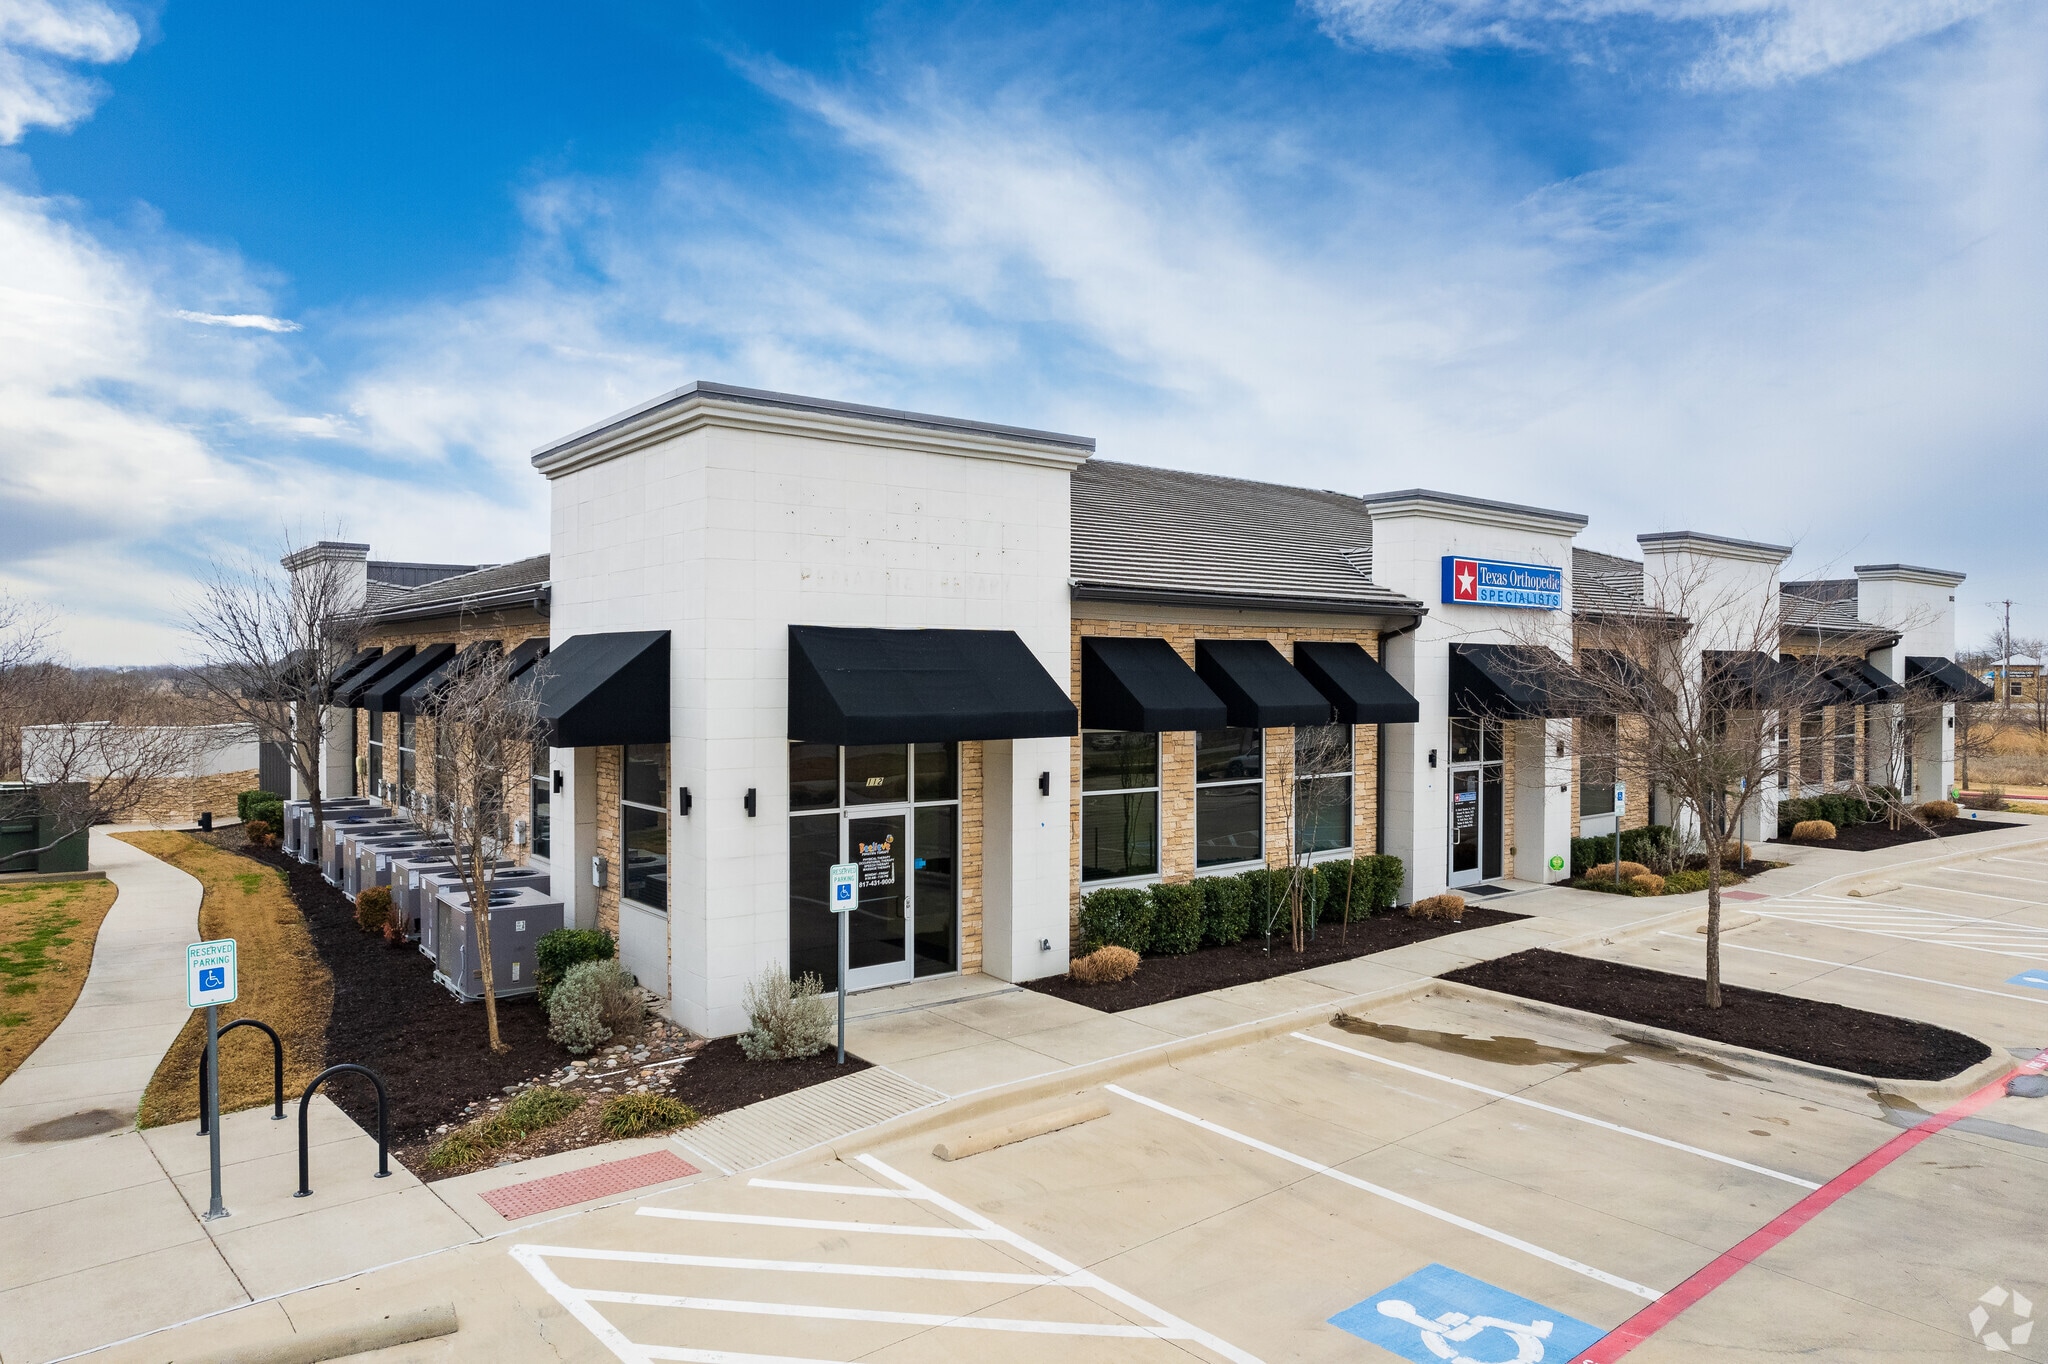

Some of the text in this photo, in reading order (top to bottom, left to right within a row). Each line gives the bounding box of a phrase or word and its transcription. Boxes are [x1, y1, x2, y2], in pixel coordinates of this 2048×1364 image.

[1480, 567, 1559, 591] Texas Orthopedic
[1481, 589, 1559, 606] SPECIALISTS
[834, 875, 854, 883] PARKING
[190, 944, 232, 957] RESERVED
[193, 956, 230, 968] PARKING
